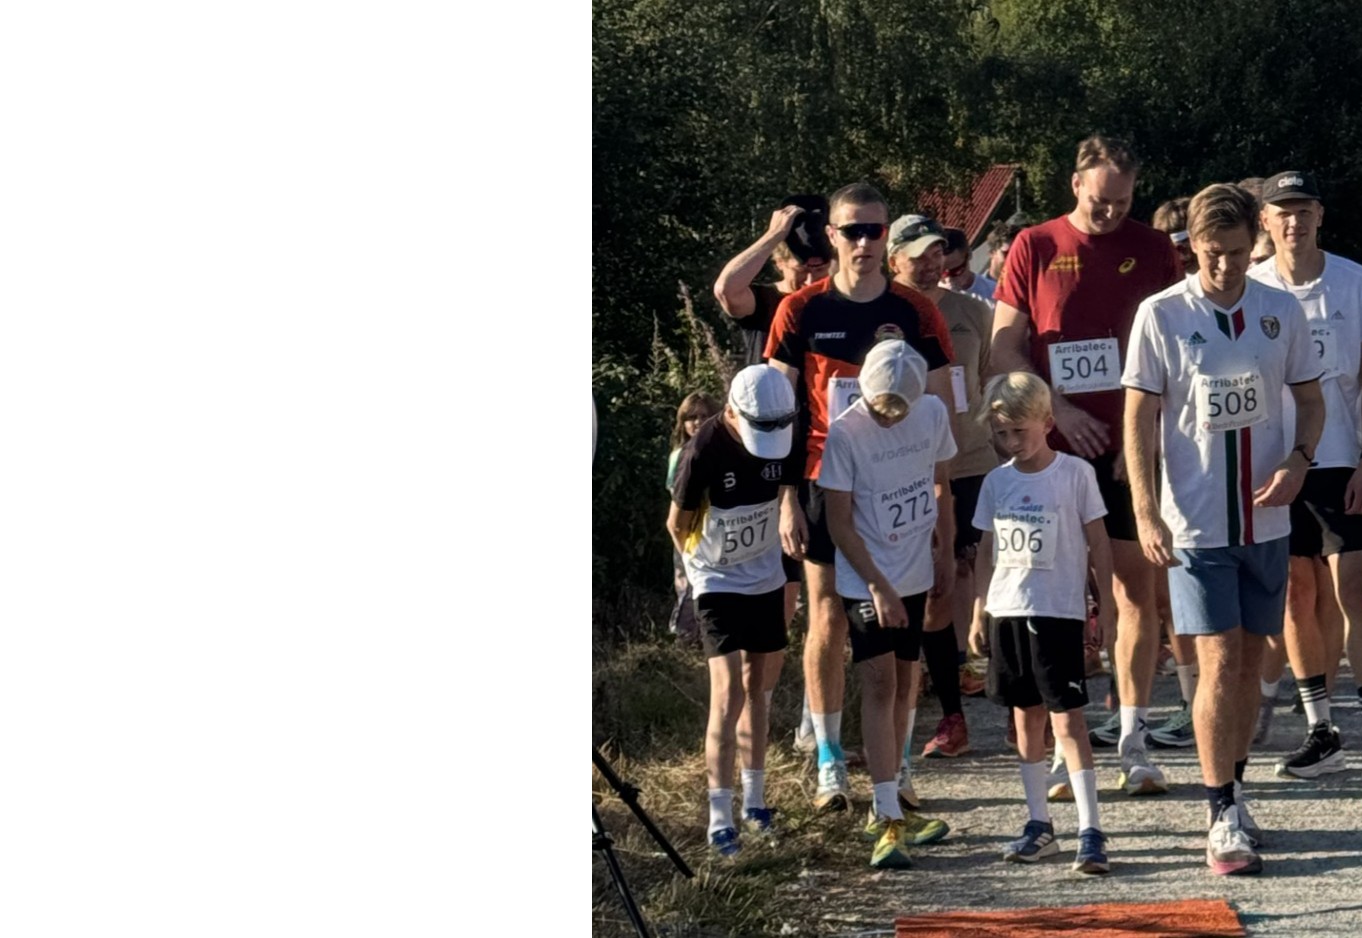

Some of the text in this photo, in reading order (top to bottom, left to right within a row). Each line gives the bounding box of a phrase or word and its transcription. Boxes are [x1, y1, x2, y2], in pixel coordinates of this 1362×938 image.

[1061, 355, 1109, 381] 504
[1208, 387, 1258, 417] 508
[888, 490, 933, 529] 272
[724, 517, 769, 554] 507
[998, 527, 1043, 554] 506
